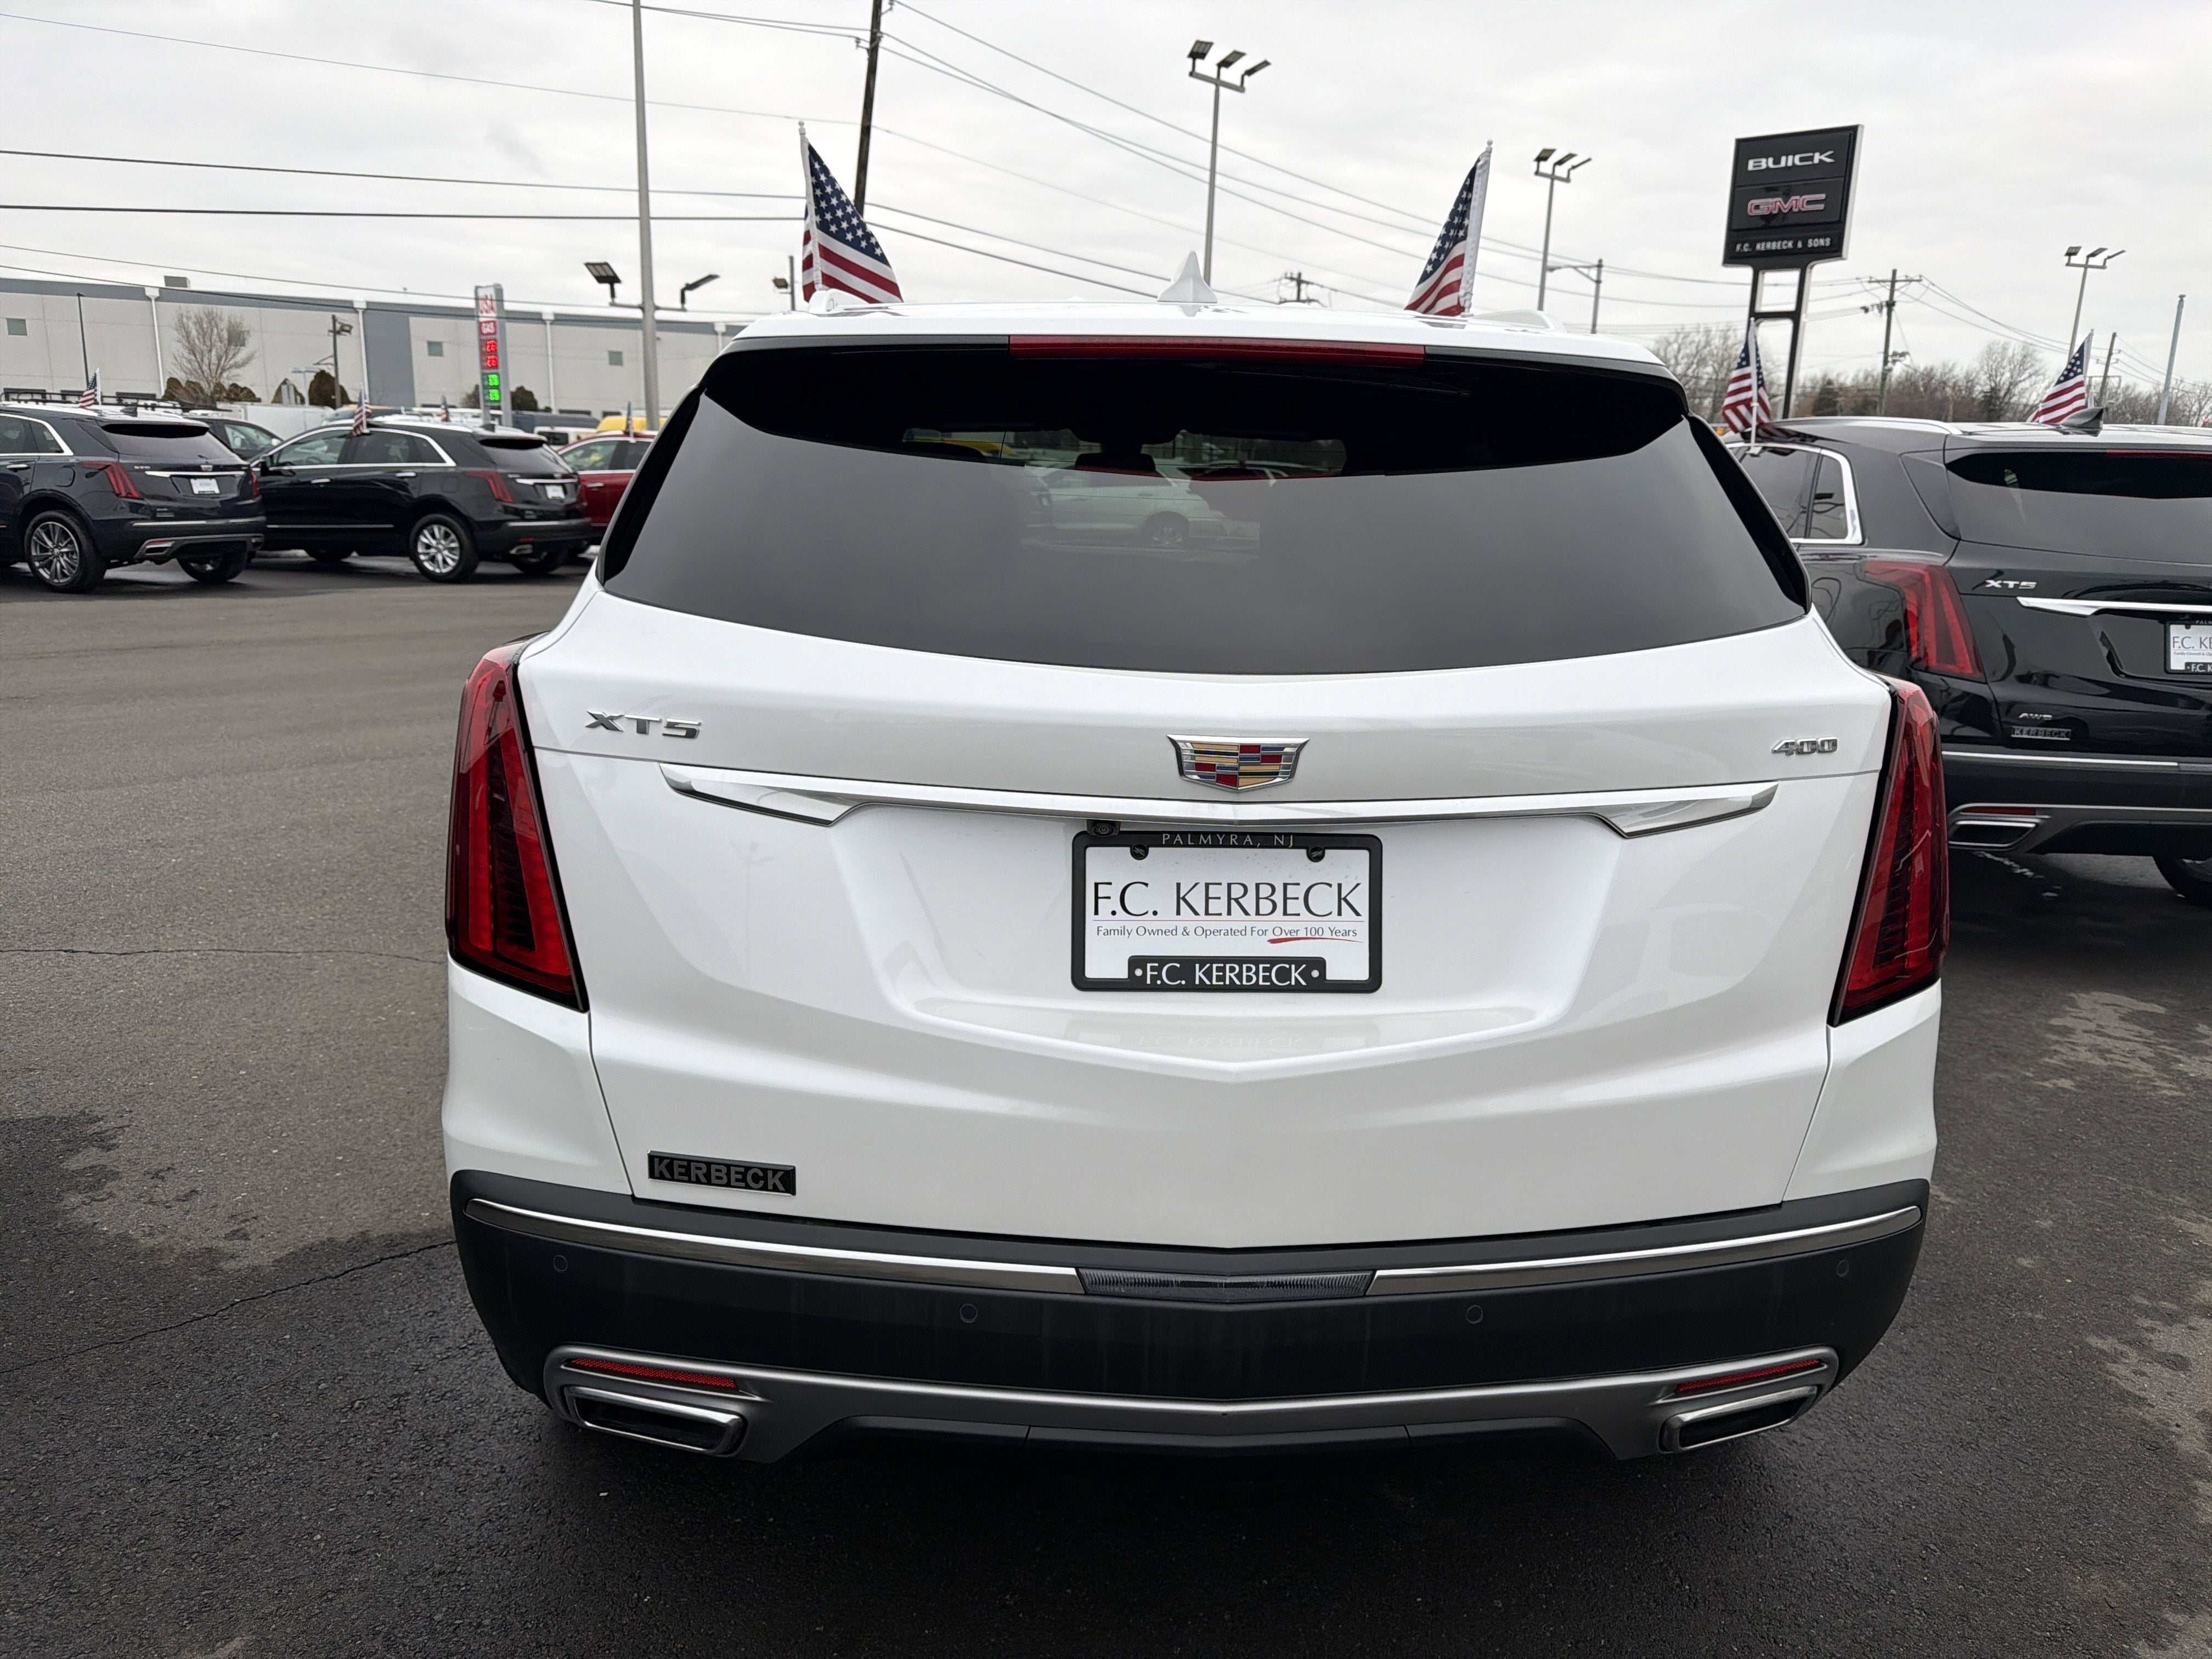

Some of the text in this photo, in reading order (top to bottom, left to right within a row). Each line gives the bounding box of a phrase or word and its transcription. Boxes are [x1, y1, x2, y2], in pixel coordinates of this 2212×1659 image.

[1747, 150, 1835, 171] BUICK
[1747, 194, 1826, 216] GMC
[1756, 239, 1794, 251] KERBECK
[1807, 237, 1831, 247] SONS
[1984, 579, 2037, 589] XT5
[2172, 636, 2195, 649] F.C.
[585, 710, 702, 739] XT5
[1771, 736, 1838, 756] 400
[1162, 833, 1293, 848] PALMYRA, NJ
[1093, 881, 1362, 917] F.C. KERBECK
[1097, 925, 1357, 939] Family Owned & Operated For Over 100 Years
[1146, 963, 1307, 986] F.C. KERBECK
[653, 1157, 786, 1192] KERBECK
